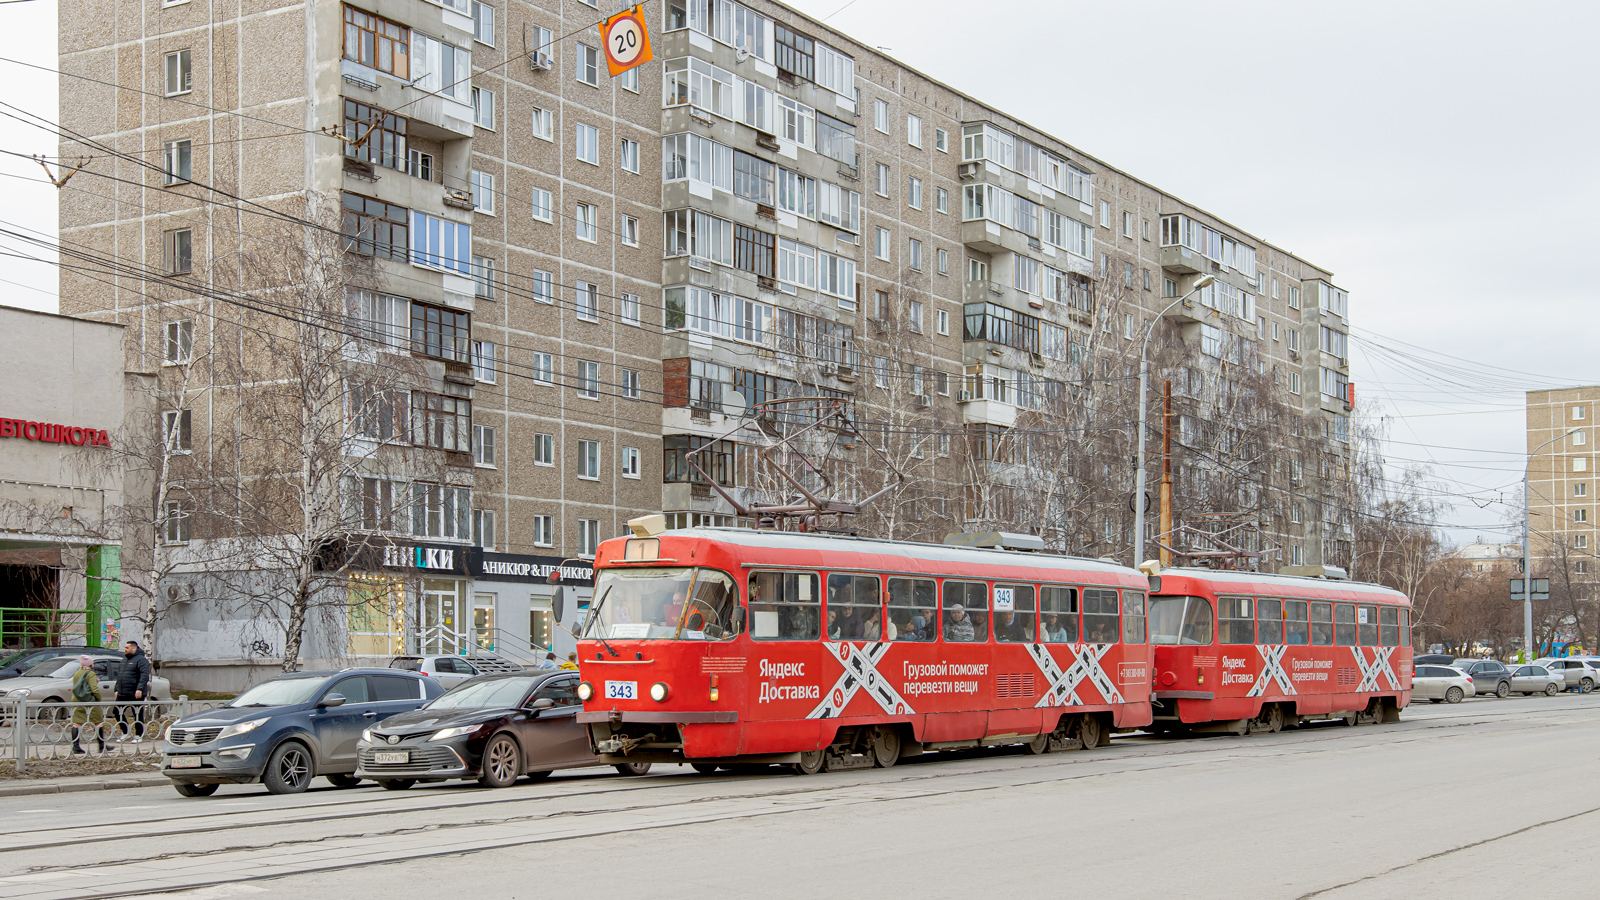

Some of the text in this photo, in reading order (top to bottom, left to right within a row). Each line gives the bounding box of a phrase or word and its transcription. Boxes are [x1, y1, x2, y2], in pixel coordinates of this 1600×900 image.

[614, 29, 637, 54] 20
[482, 561, 594, 581] АНИКЮР&ПЕДИКЮР
[996, 590, 1011, 604] 343
[759, 658, 805, 679] Яндекс
[903, 660, 989, 680] Грузовой поможет
[1222, 655, 1246, 669] Яндекс
[1292, 658, 1334, 671] Грузовой поможет
[1221, 671, 1254, 686] Доставка
[1292, 672, 1316, 683] перевезти
[610, 685, 633, 698] 343
[758, 682, 820, 704] Доставка
[903, 681, 978, 698] перевезти вещи
